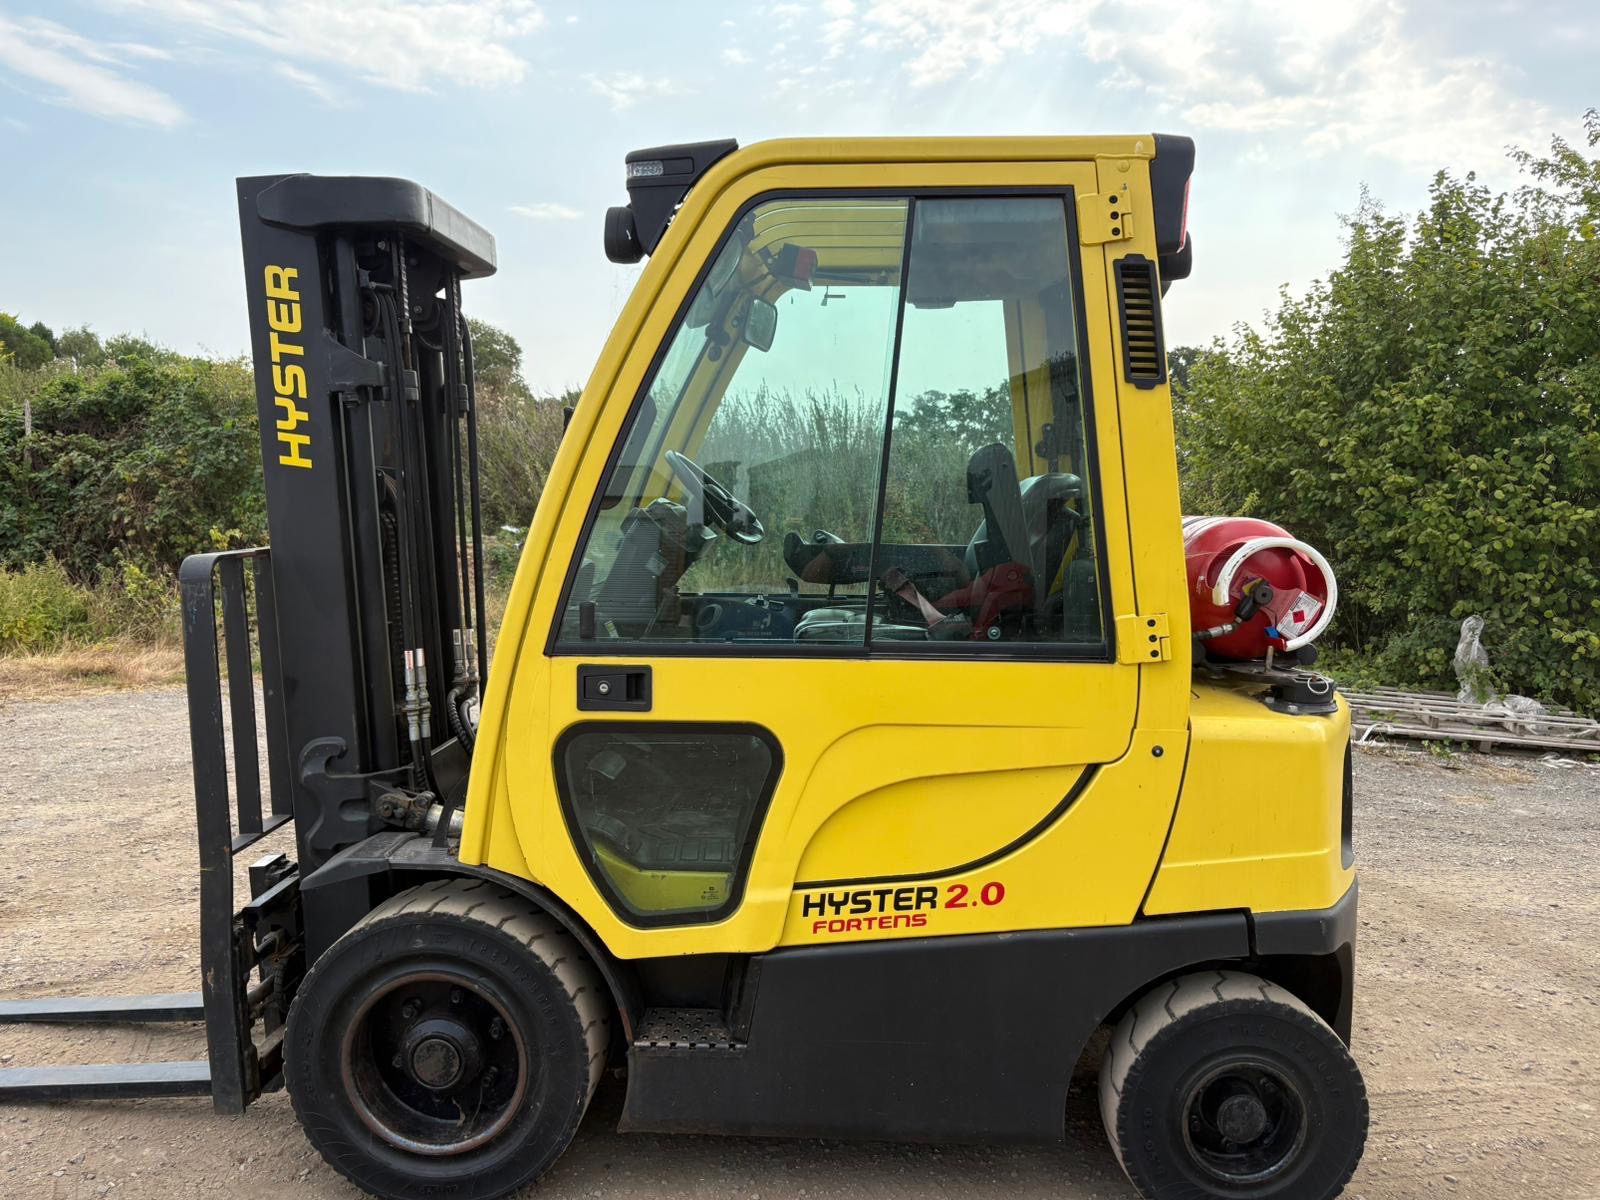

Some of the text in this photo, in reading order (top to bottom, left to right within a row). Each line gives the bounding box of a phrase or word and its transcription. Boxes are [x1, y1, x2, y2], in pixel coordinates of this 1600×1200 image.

[265, 264, 313, 469] HYSTER
[802, 881, 1006, 917] HYSTER 2.0
[812, 913, 928, 935] FORTENS
